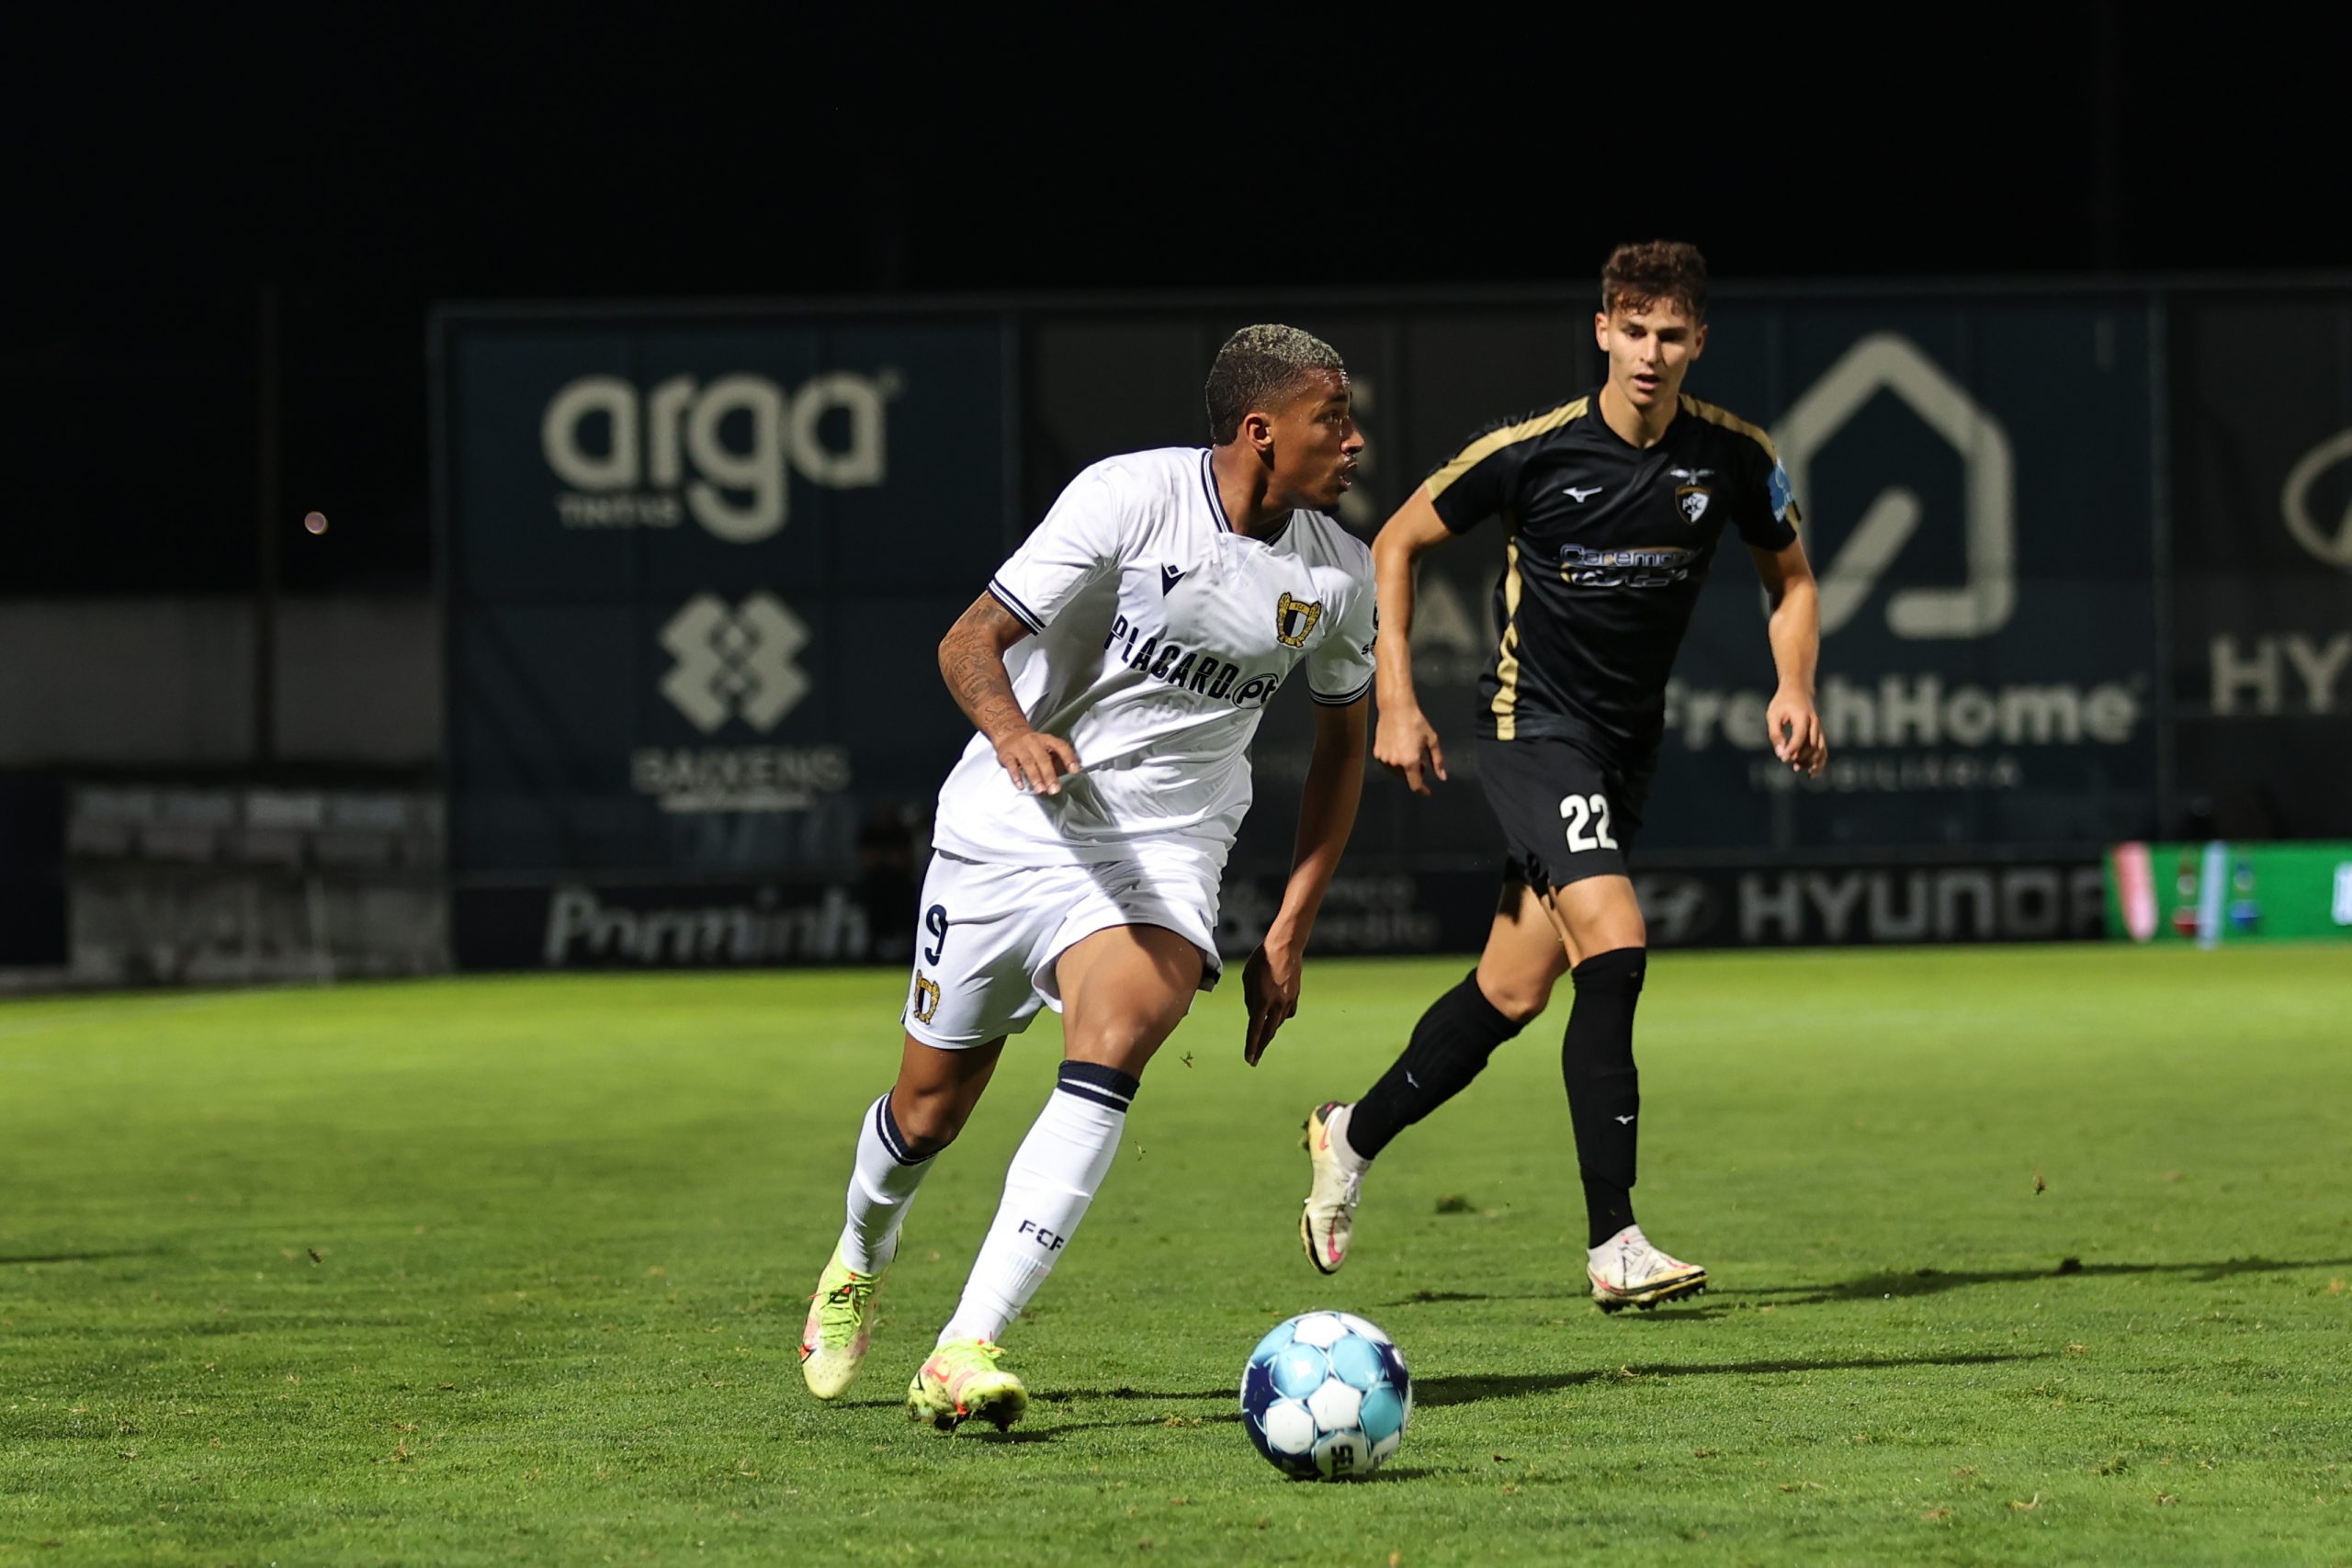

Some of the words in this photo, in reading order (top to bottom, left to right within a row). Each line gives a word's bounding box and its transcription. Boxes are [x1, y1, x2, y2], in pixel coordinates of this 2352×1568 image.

[540, 372, 888, 544] arga
[1559, 793, 1619, 853] 22
[924, 904, 948, 966] 9
[1738, 867, 2104, 944] HYUNDA
[1018, 1219, 1064, 1251] FCF
